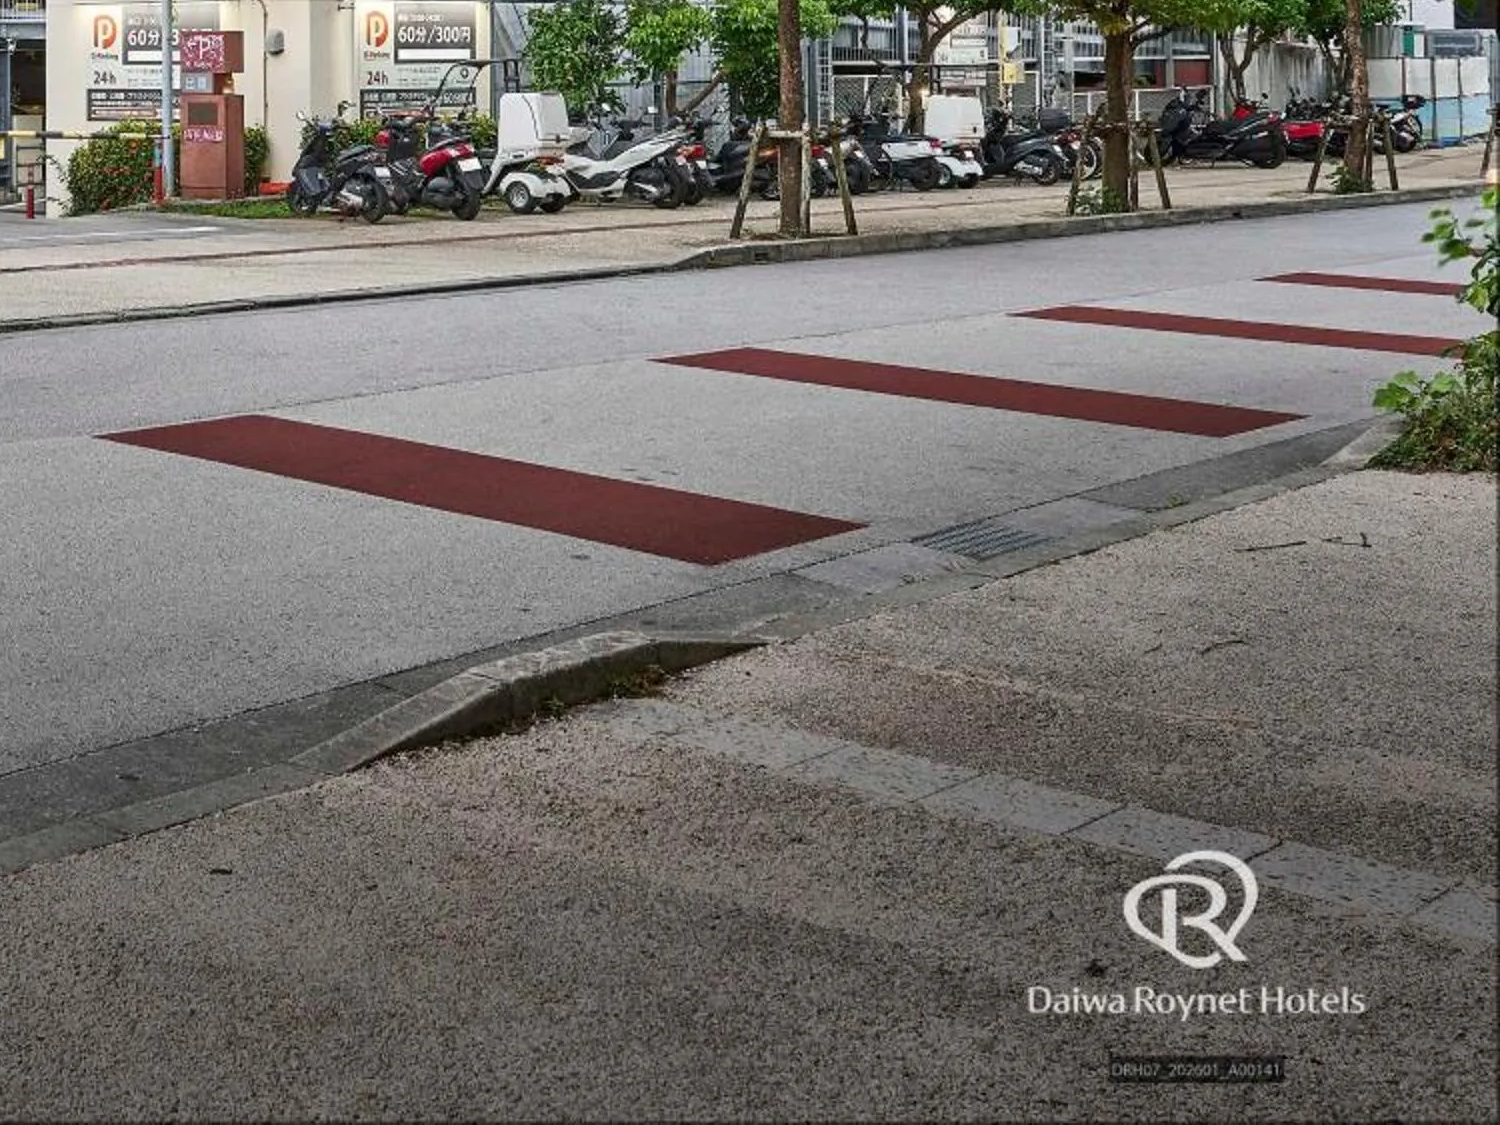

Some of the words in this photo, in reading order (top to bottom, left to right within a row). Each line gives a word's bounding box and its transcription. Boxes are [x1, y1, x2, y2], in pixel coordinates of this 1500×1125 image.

[398, 25, 471, 43] 60分/300円
[93, 70, 117, 85] 24h
[367, 71, 389, 85] 24h
